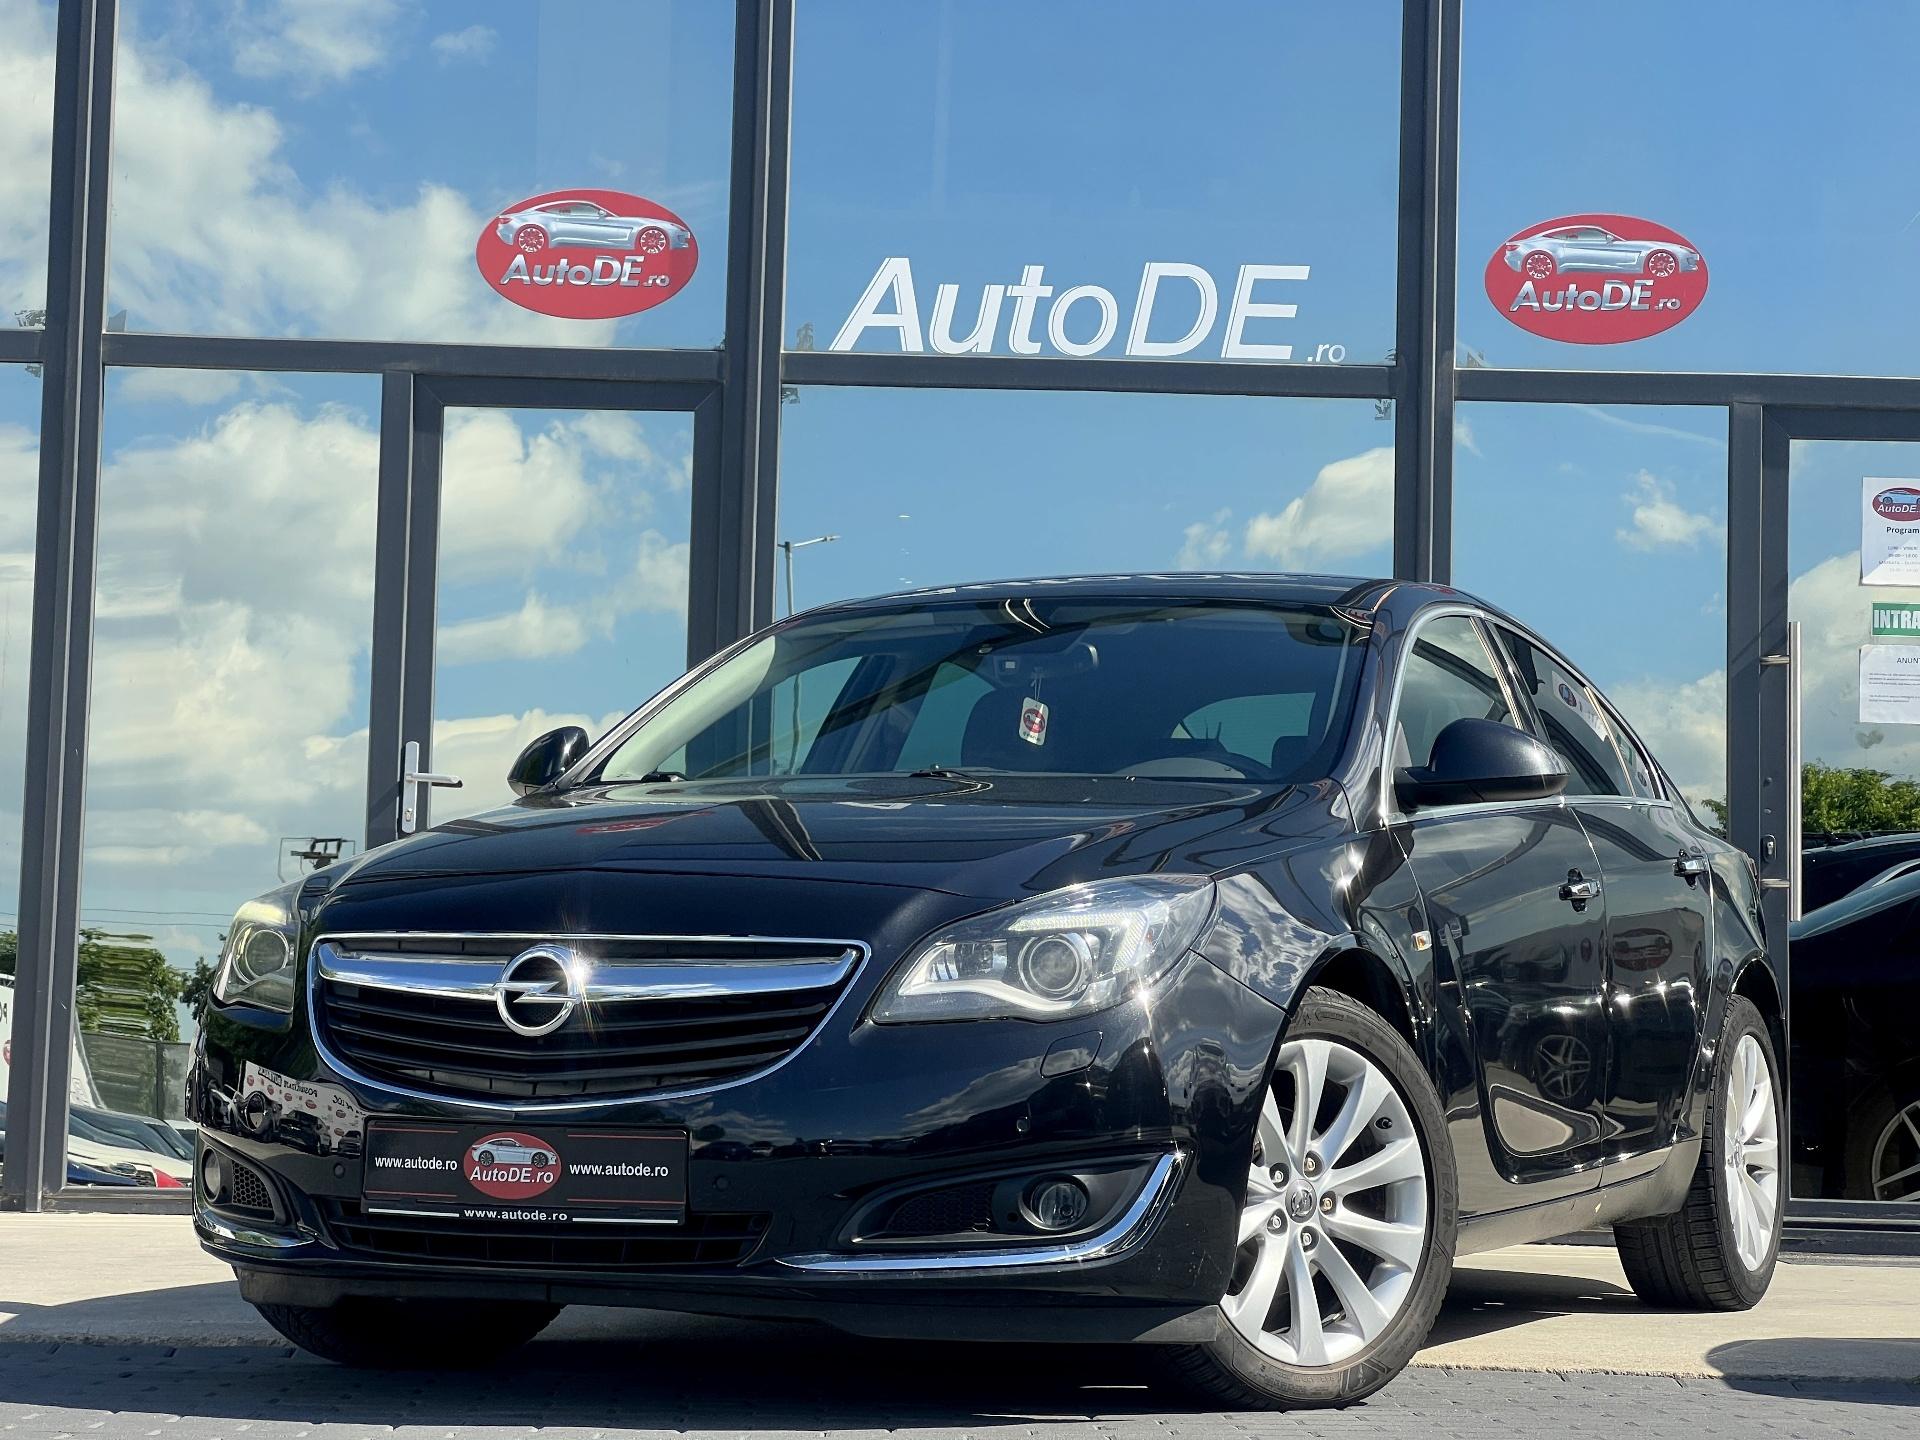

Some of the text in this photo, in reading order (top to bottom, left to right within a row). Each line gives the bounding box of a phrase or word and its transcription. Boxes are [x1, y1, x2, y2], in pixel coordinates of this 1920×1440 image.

[375, 1155, 458, 1171] www.autode.ro
[569, 1162, 669, 1178] www.autode.ro
[470, 1166, 555, 1184] AutoDE.ro
[463, 1208, 568, 1222] www.autode.ro
